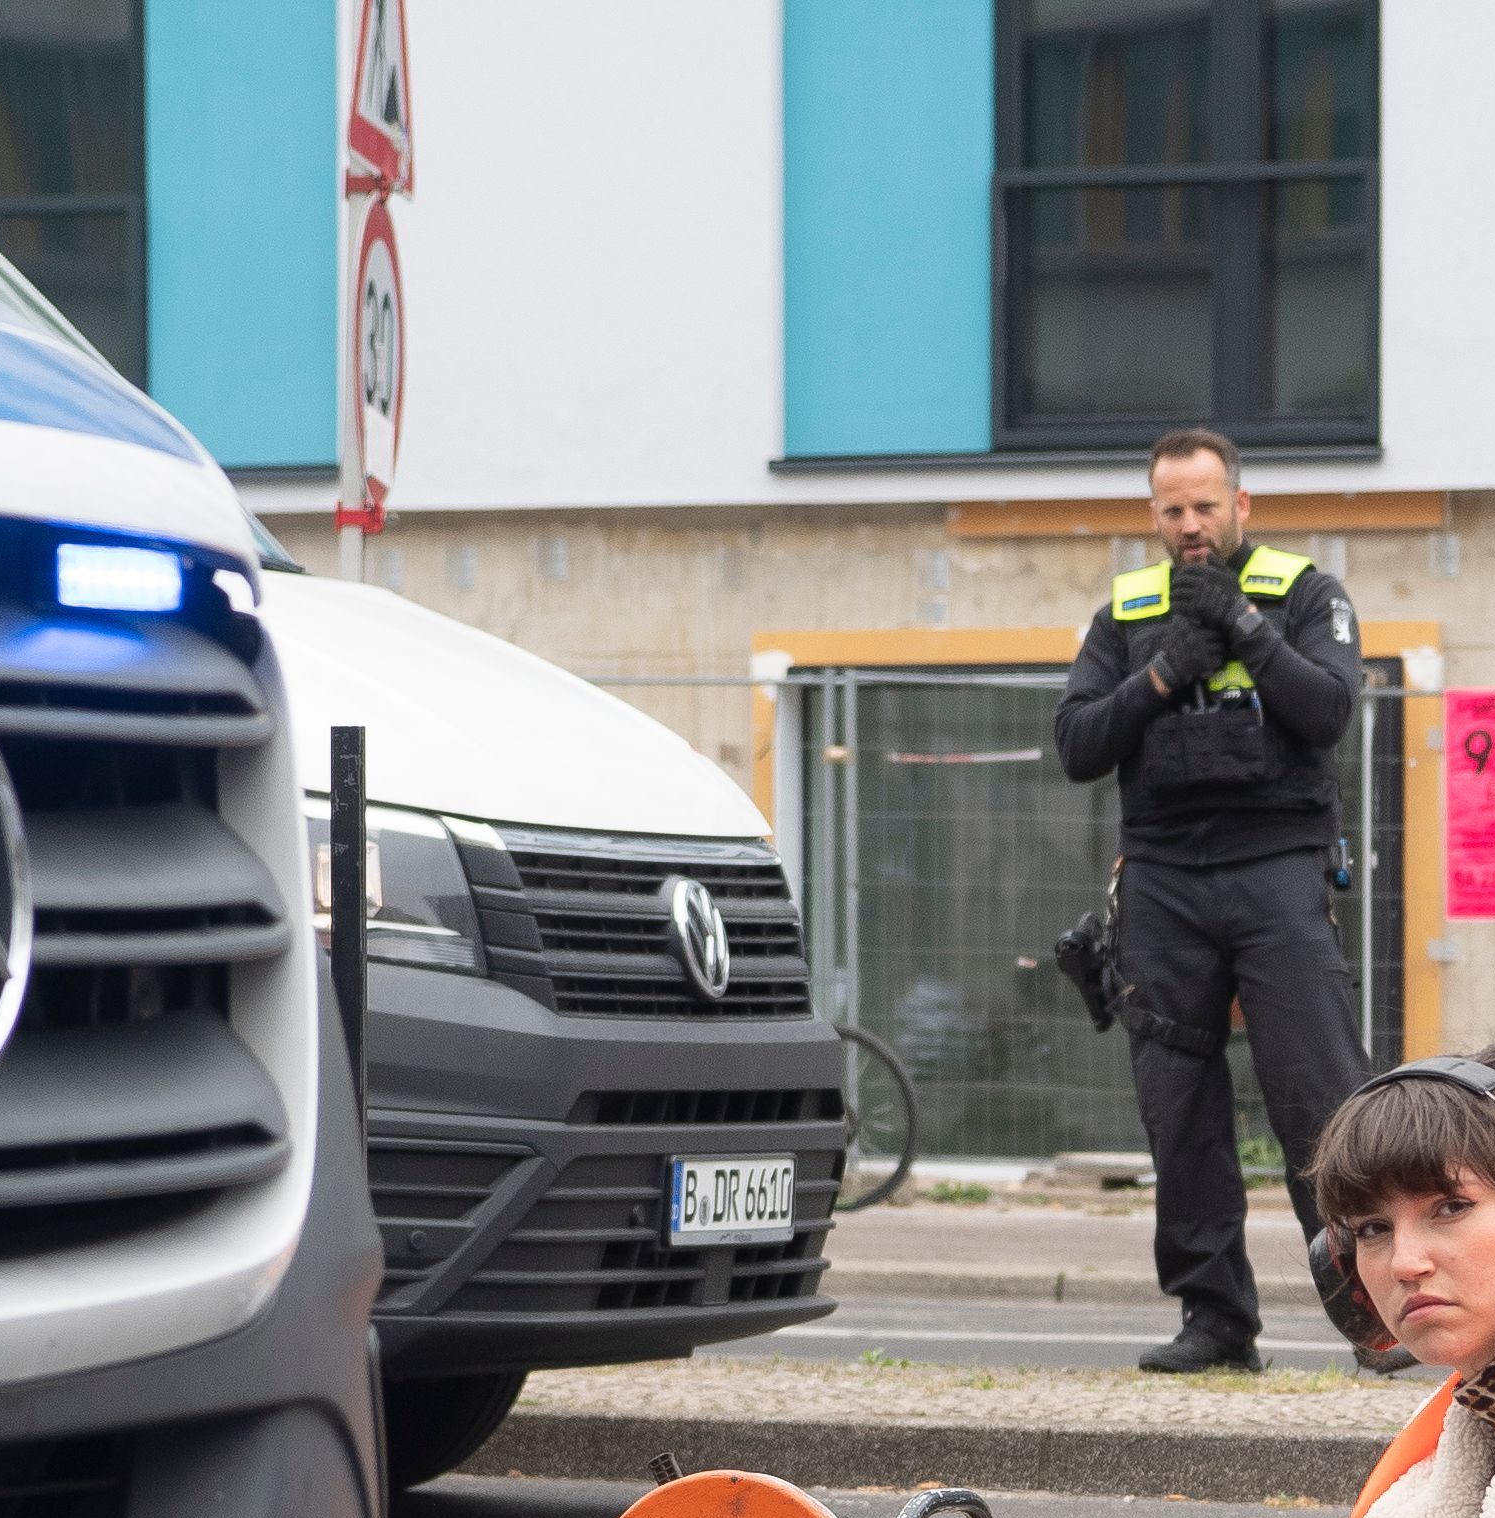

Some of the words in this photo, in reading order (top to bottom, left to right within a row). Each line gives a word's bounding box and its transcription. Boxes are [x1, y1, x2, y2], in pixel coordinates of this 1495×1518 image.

[364, 278, 395, 416] 30
[684, 1169, 698, 1223] B
[712, 1168, 741, 1223] DR
[745, 1167, 793, 1221] 6610
